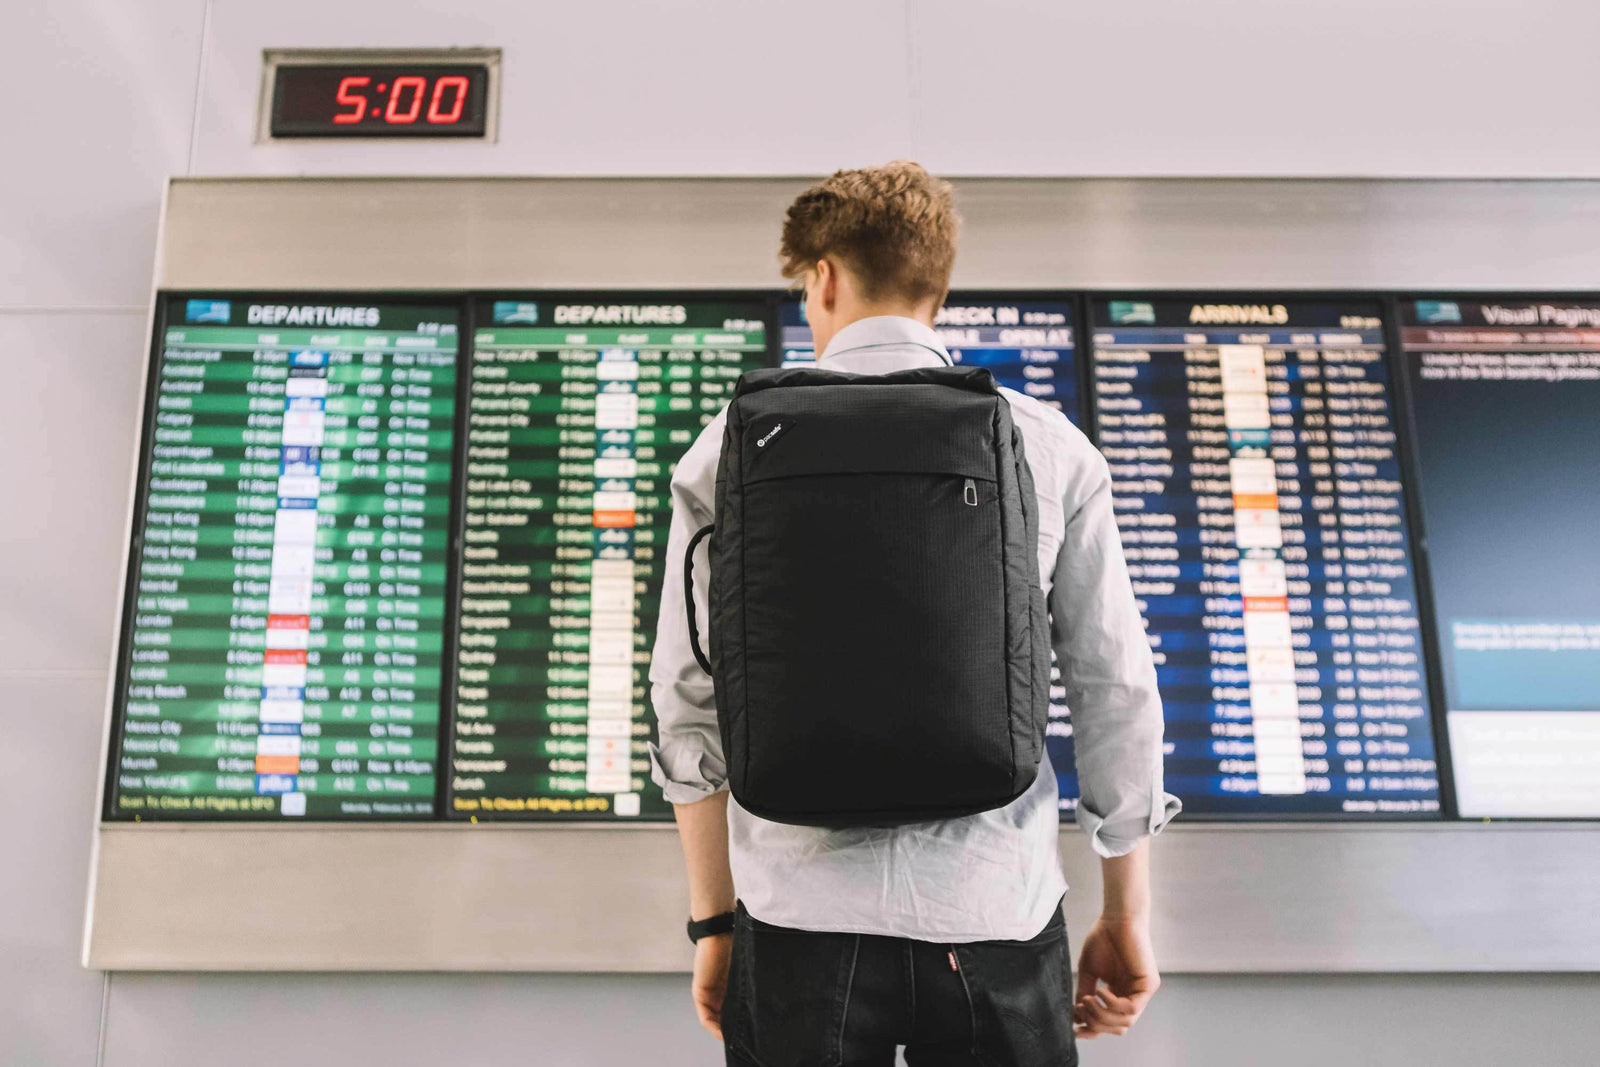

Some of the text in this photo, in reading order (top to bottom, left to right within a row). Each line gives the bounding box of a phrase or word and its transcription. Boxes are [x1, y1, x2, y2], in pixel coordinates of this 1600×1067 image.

[333, 77, 469, 124] 5:00
[248, 304, 380, 327] DEPARTURES
[554, 305, 687, 325] DEPARTURES
[934, 306, 994, 325] HECK
[996, 306, 1019, 325] IN
[1189, 304, 1289, 325] ARRIVALS
[1481, 304, 1540, 325] Visual
